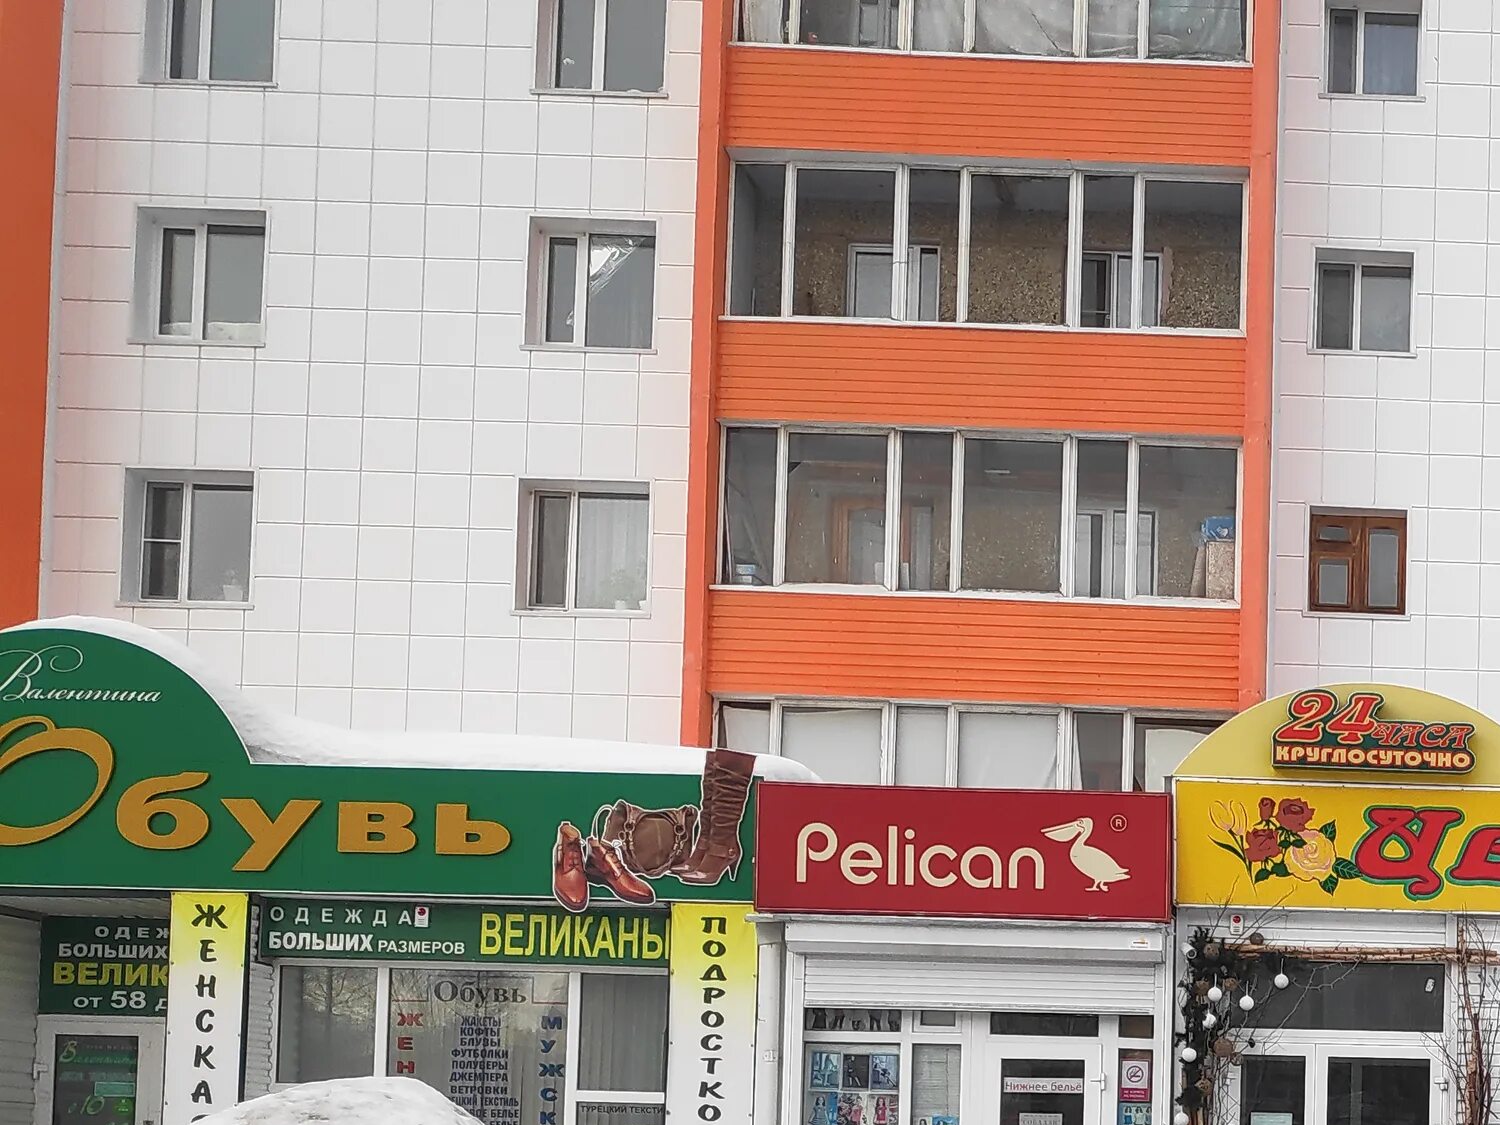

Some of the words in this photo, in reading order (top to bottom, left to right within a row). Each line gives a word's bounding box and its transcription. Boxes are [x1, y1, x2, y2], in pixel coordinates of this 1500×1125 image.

[0, 645, 162, 703] Валентина
[1275, 692, 1381, 744] 24
[1275, 745, 1471, 769] КРУГЛОСУТОЧНО
[0, 715, 512, 872] Обувь
[796, 821, 1045, 890] Pelican
[269, 905, 412, 926] ОДЕЖДА
[267, 931, 373, 952] БОЛЬШИХ
[377, 940, 465, 954] РАЗМЕРОВ
[479, 912, 669, 960] ВЕЛИКАНЫ
[58, 943, 168, 960] БОЛЬШИХ
[110, 990, 147, 1009] 58
[433, 980, 526, 1008] Обувь
[191, 903, 229, 1123] ЖЕНСКА
[461, 1016, 501, 1027] ЖАКЕТЫ
[460, 1027, 500, 1037] КОФТЫ
[451, 1048, 508, 1059] ФУТБОЛКИ
[449, 1072, 508, 1082] ДЖЕМПЕРА
[1005, 1081, 1048, 1092] Нижнее
[451, 1085, 507, 1095] ВЕТРОВКИ
[491, 1110, 519, 1118] БЕЛЬЕ
